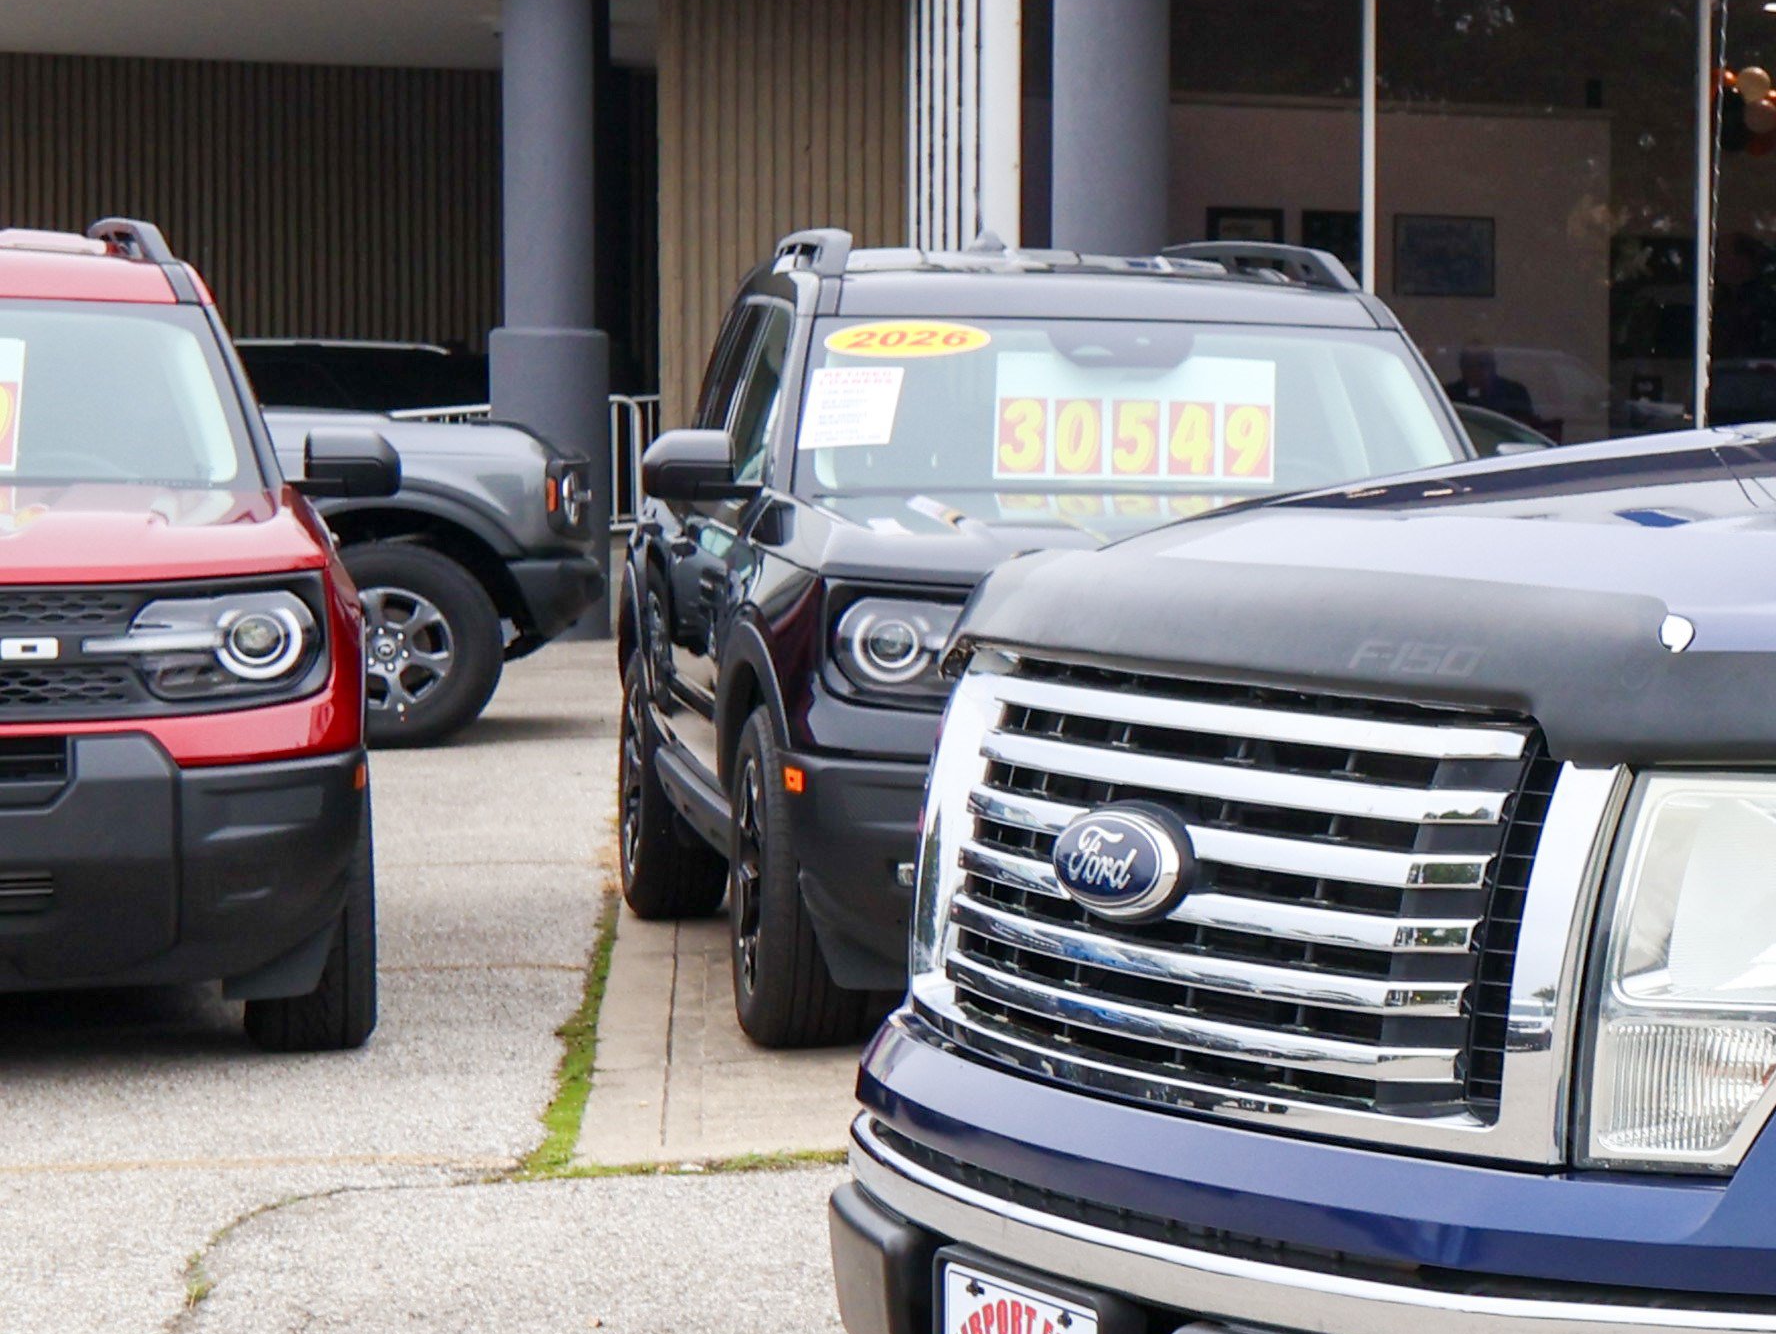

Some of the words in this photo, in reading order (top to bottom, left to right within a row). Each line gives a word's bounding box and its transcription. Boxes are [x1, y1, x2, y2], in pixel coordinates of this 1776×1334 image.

[847, 330, 971, 349] 2026
[1001, 398, 1269, 475] 30549
[1069, 825, 1137, 890] Ford
